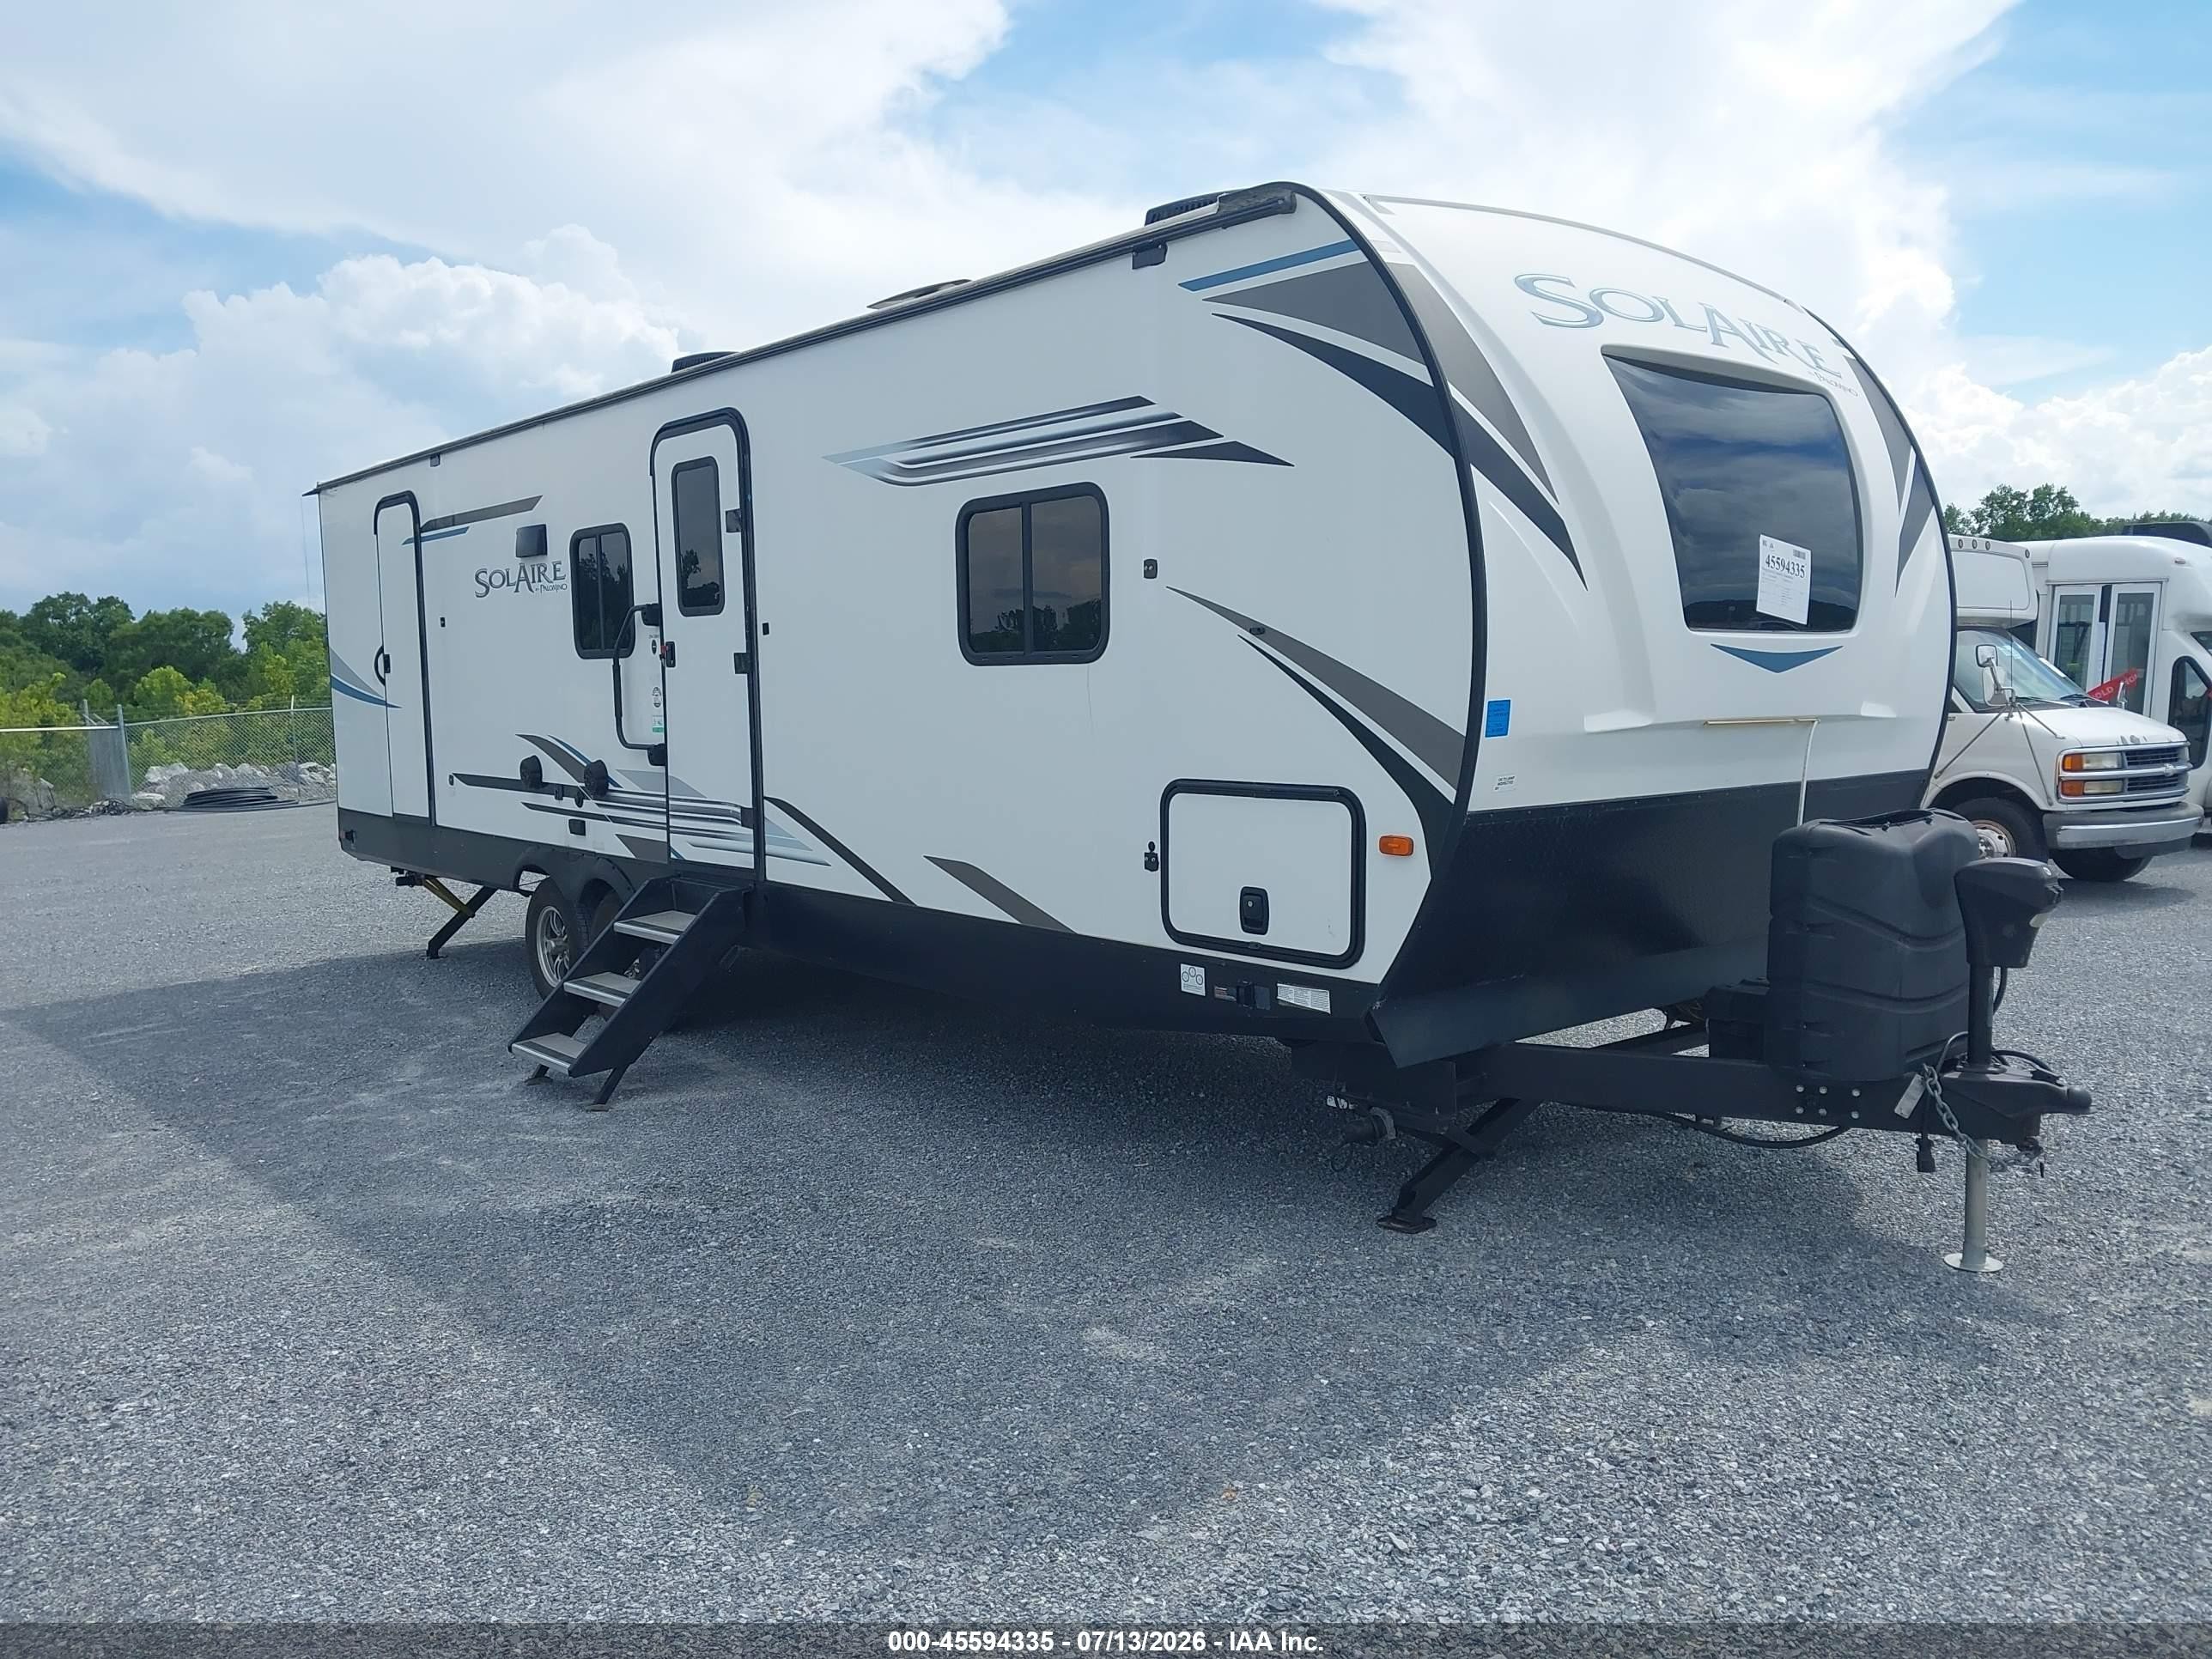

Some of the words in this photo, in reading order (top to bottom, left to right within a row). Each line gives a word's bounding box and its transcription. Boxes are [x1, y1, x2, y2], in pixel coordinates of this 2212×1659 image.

[1514, 273, 1842, 379] SOLAIRE
[474, 561, 566, 599] SOLAIRE
[1765, 554, 1806, 579] 45594335
[539, 583, 568, 594] PALOMINO
